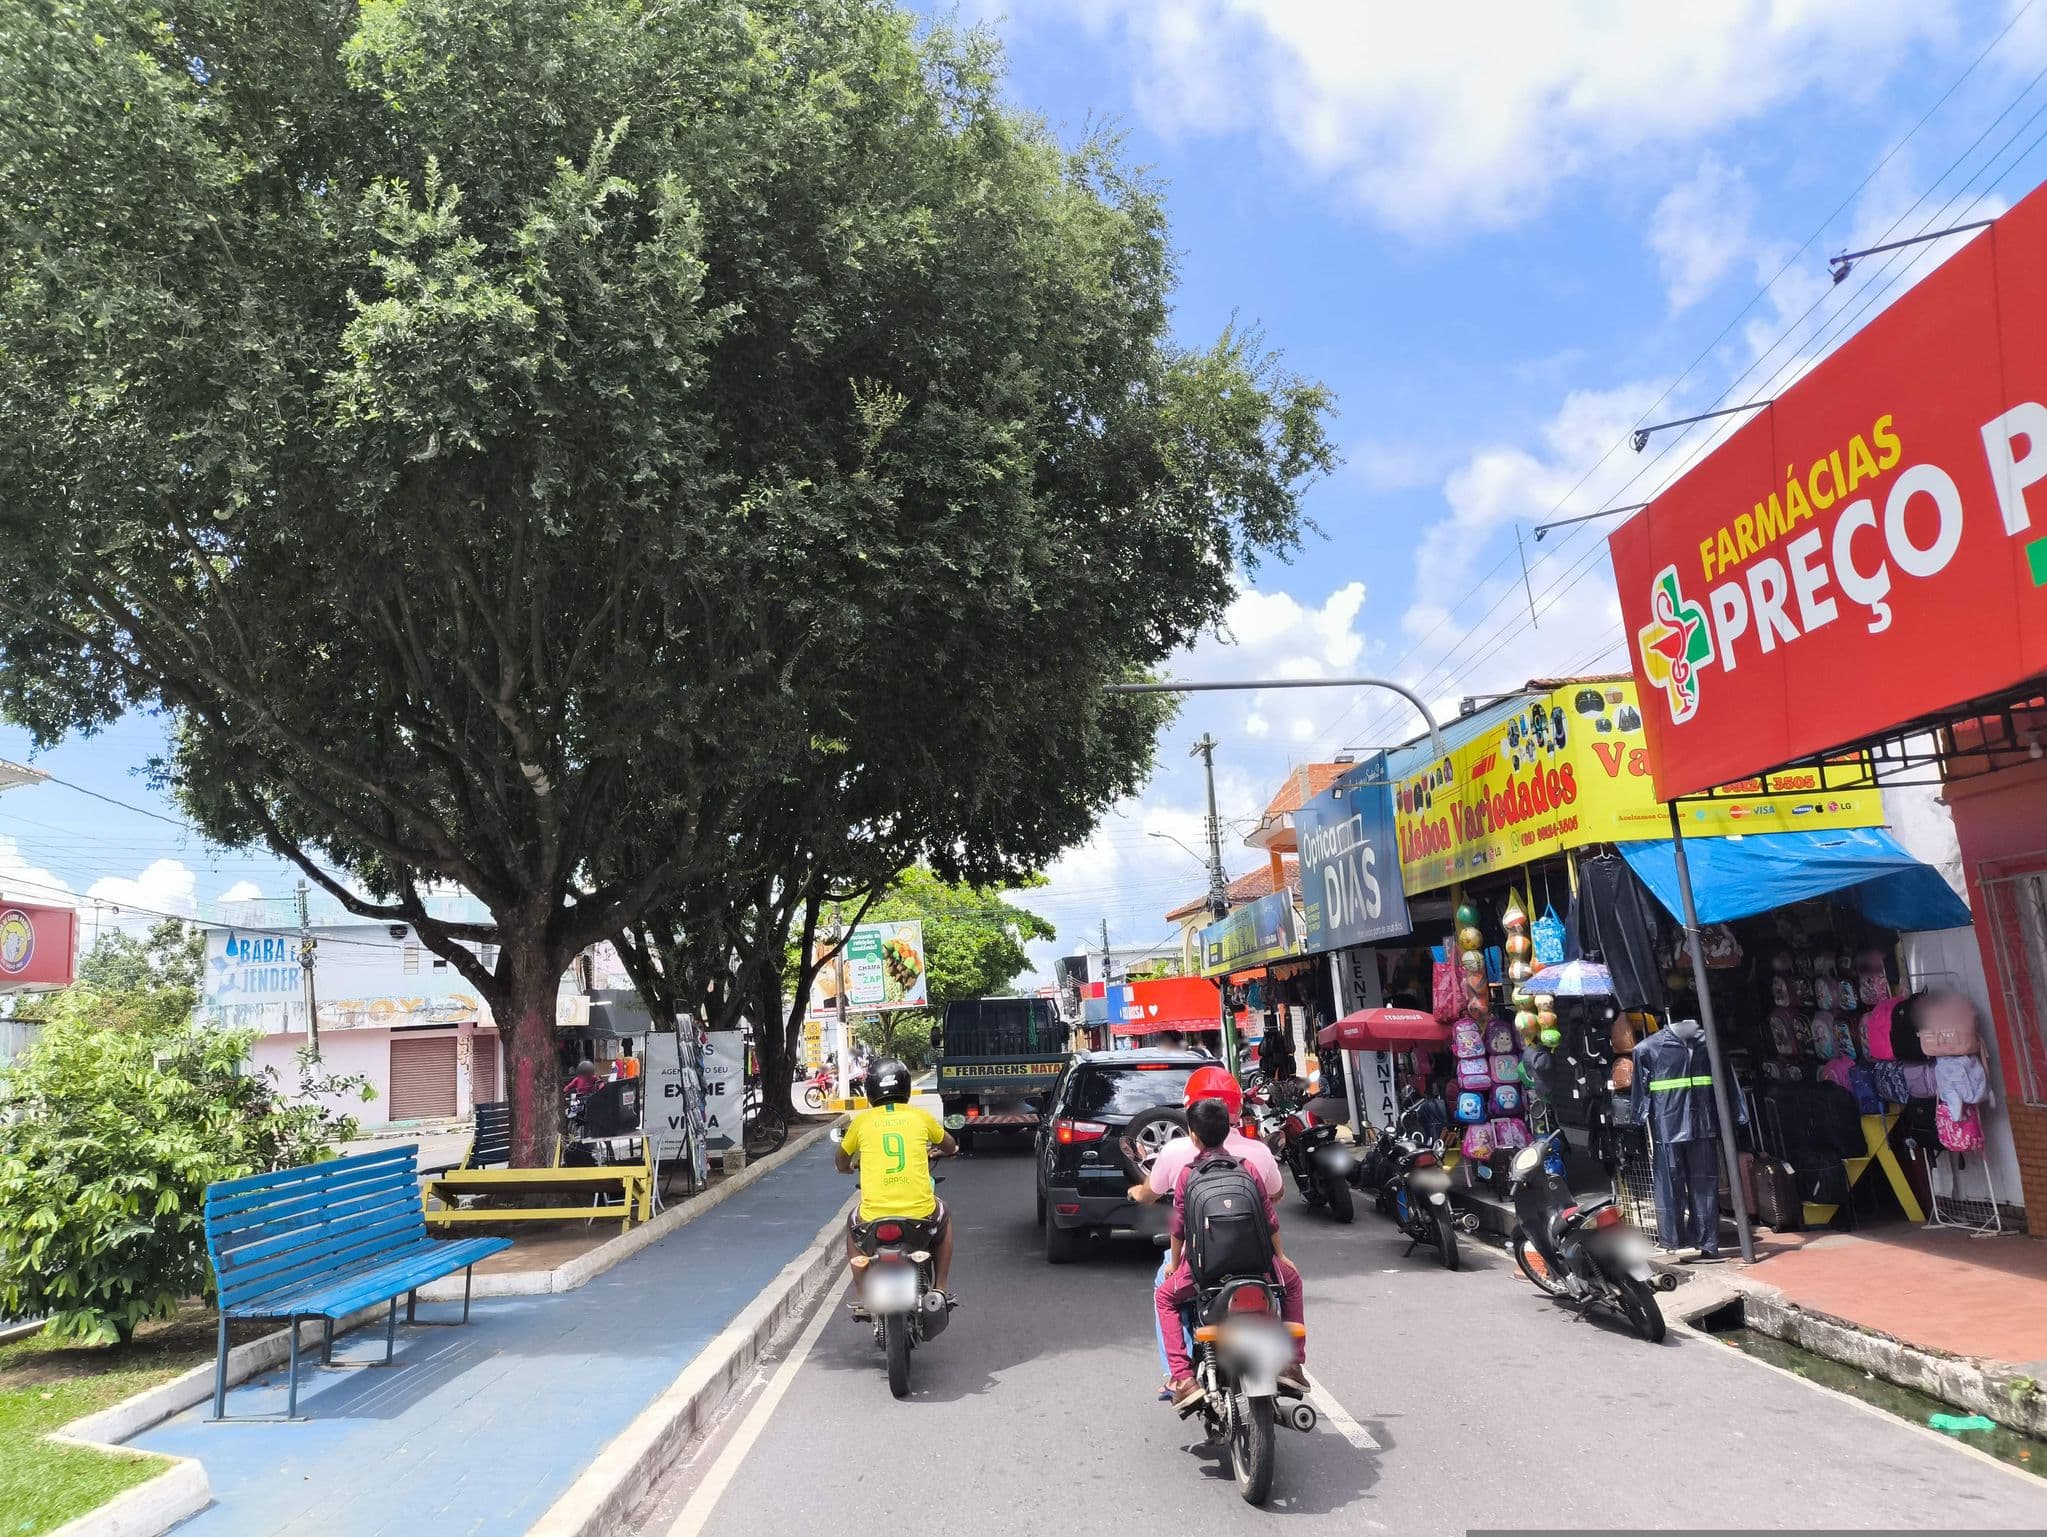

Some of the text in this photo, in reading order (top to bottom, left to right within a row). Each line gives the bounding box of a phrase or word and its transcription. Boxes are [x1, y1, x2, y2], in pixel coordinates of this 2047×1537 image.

[1700, 414, 1901, 582] FARMÁCIAS
[1708, 463, 1963, 673] PREÇO
[1399, 814, 1451, 865] Lisboa
[1450, 760, 1577, 845] Variedades
[1753, 805, 1775, 815] VISA
[1303, 823, 1337, 873] Óptica
[1324, 847, 1382, 930] DIAS
[863, 975, 882, 984] ZAP
[713, 1066, 728, 1074] SEU
[955, 1065, 1028, 1076] FERRAGENS
[883, 1132, 906, 1175] 9
[883, 1177, 911, 1186] BRASIL
